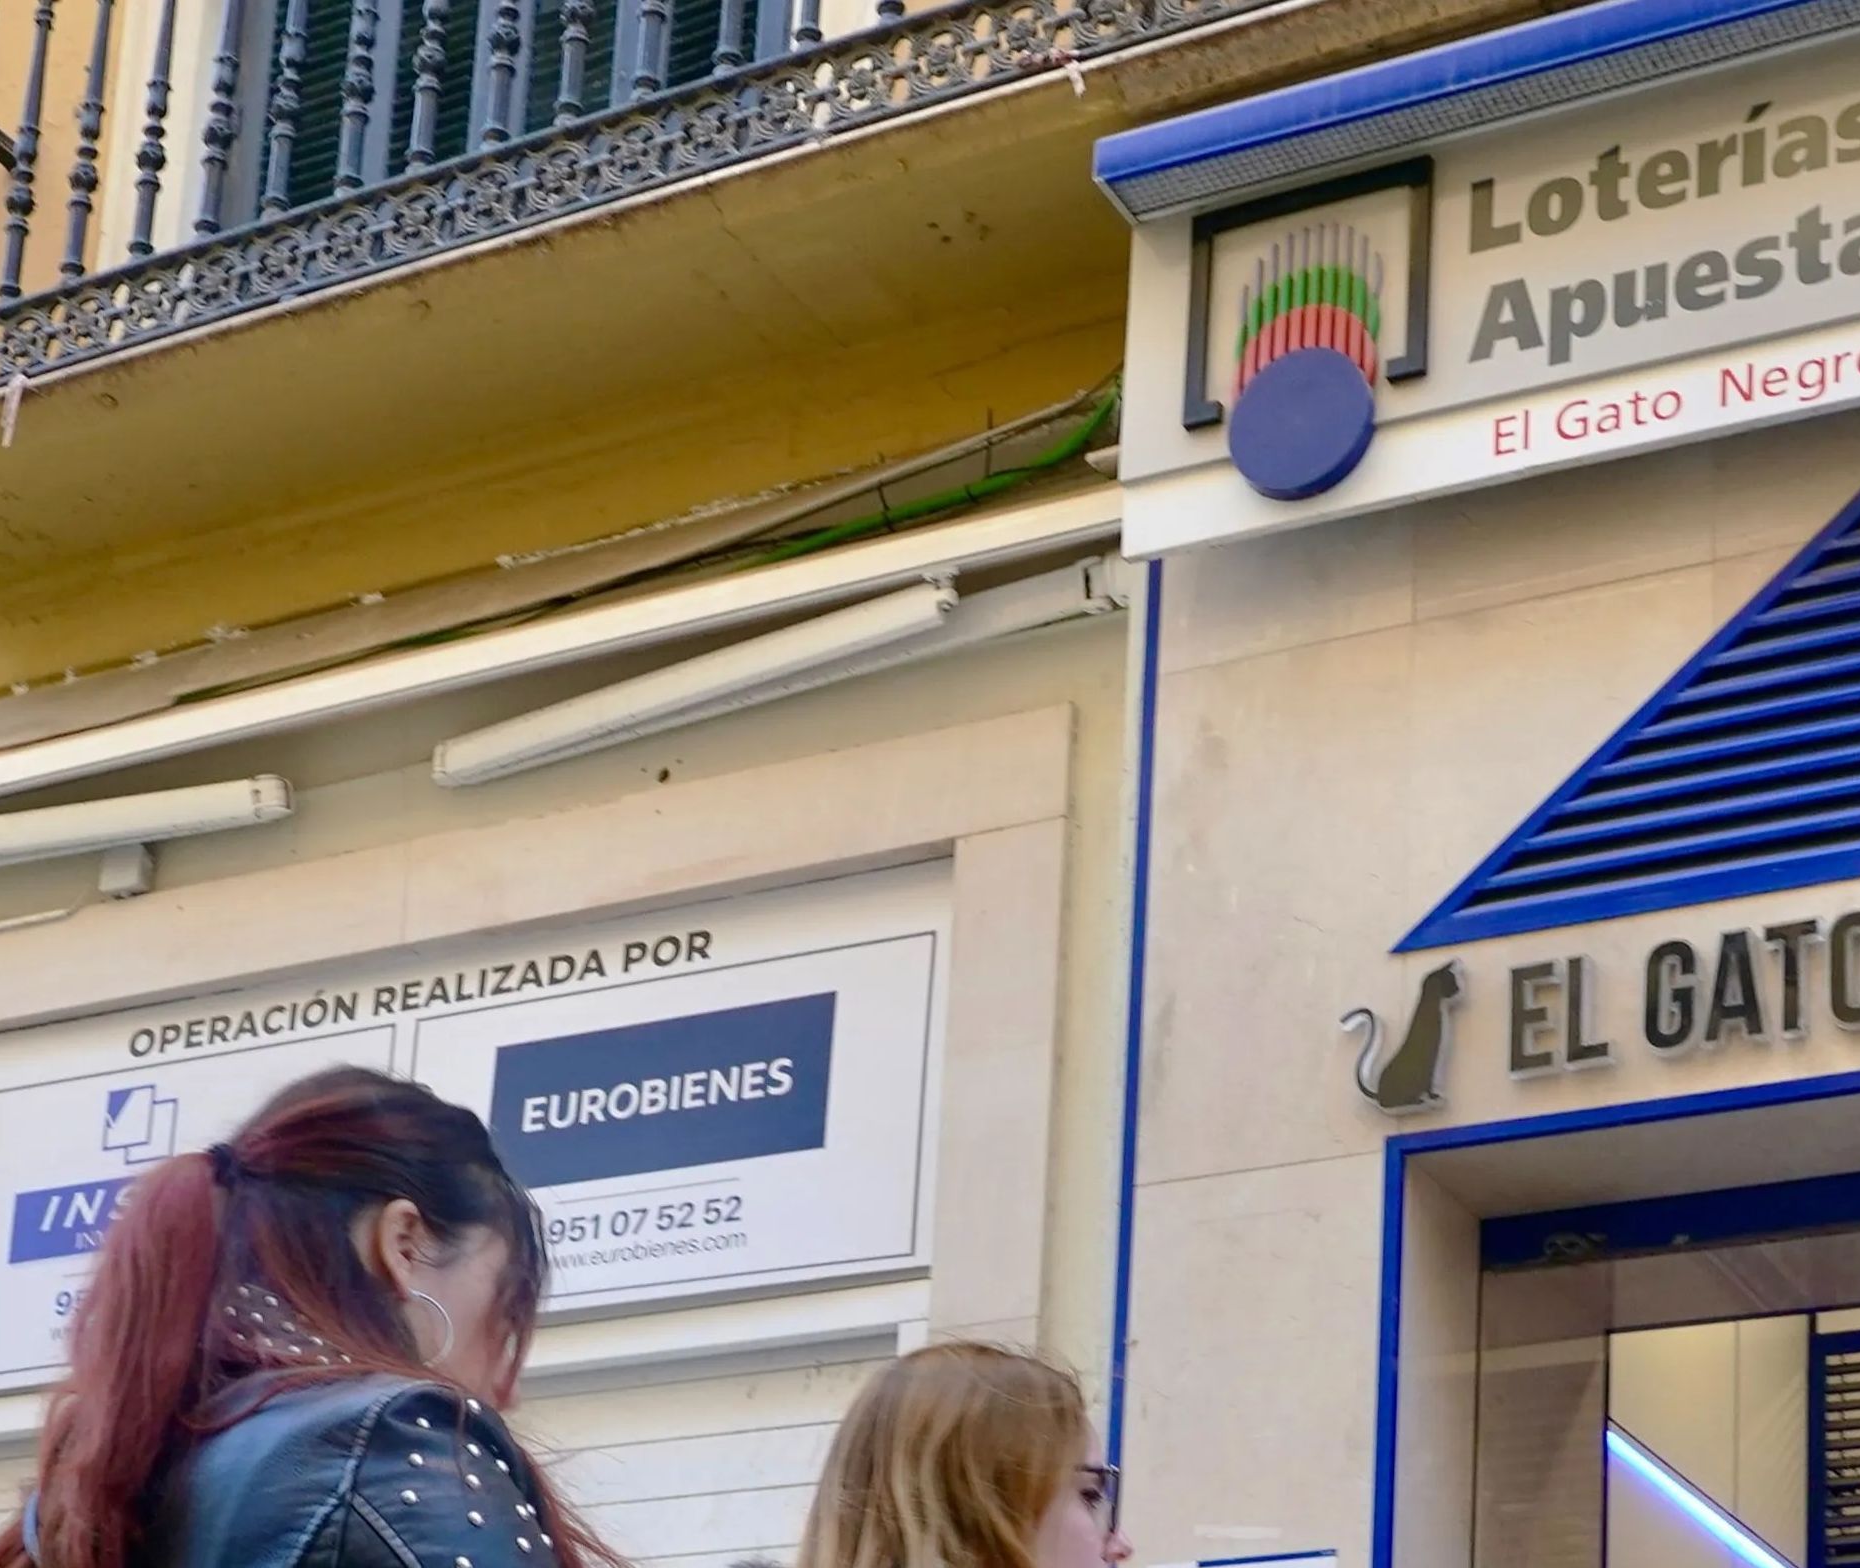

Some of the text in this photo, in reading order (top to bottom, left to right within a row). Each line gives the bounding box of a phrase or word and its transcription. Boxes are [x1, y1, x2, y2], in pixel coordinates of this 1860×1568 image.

[1492, 409, 1532, 457] El
[1554, 388, 1683, 442] Gato
[128, 930, 712, 1058] OPERACIÓN REALIZADA POR
[1508, 954, 1609, 1078] EL
[520, 1056, 795, 1134] EUROBIENES
[547, 1195, 743, 1245] 951 07 52 52
